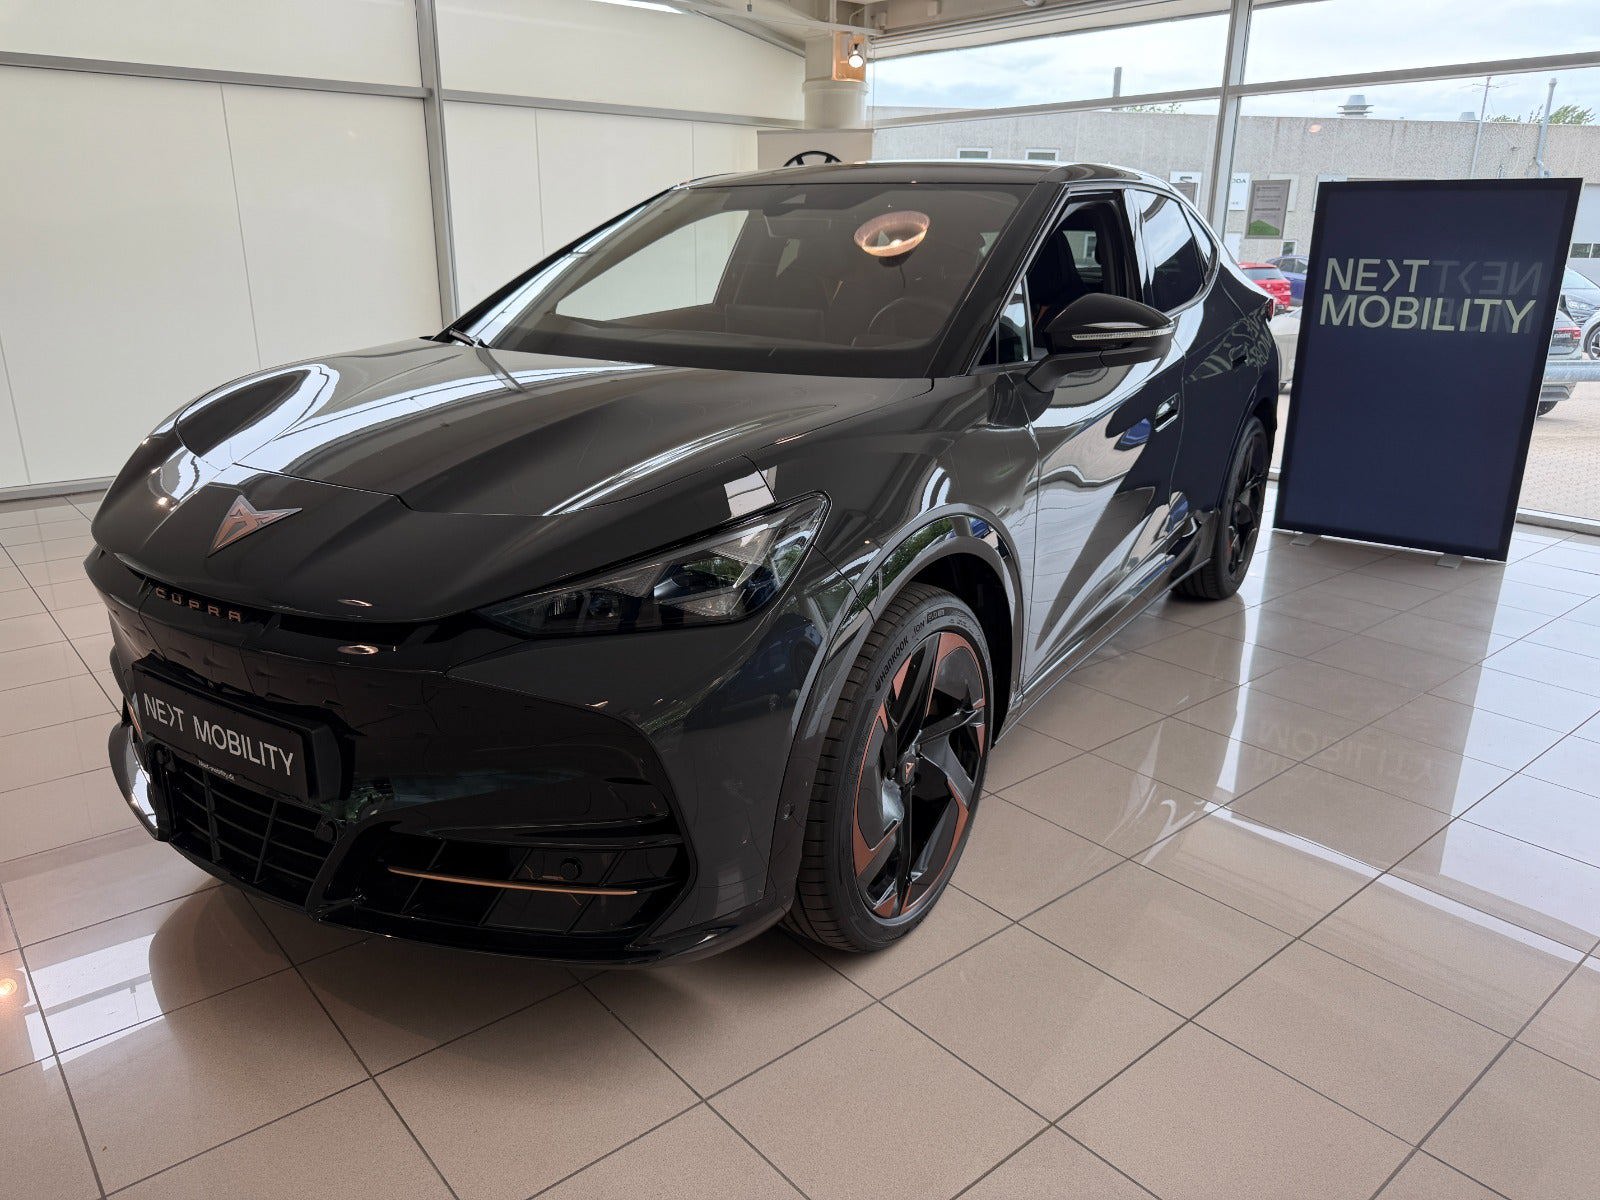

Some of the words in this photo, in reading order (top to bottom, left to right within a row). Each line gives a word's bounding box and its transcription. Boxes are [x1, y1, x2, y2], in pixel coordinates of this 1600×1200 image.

[1319, 293, 1537, 334] MOBILITY
[155, 587, 241, 623] CUPRA
[192, 715, 294, 776] MOBILITY
